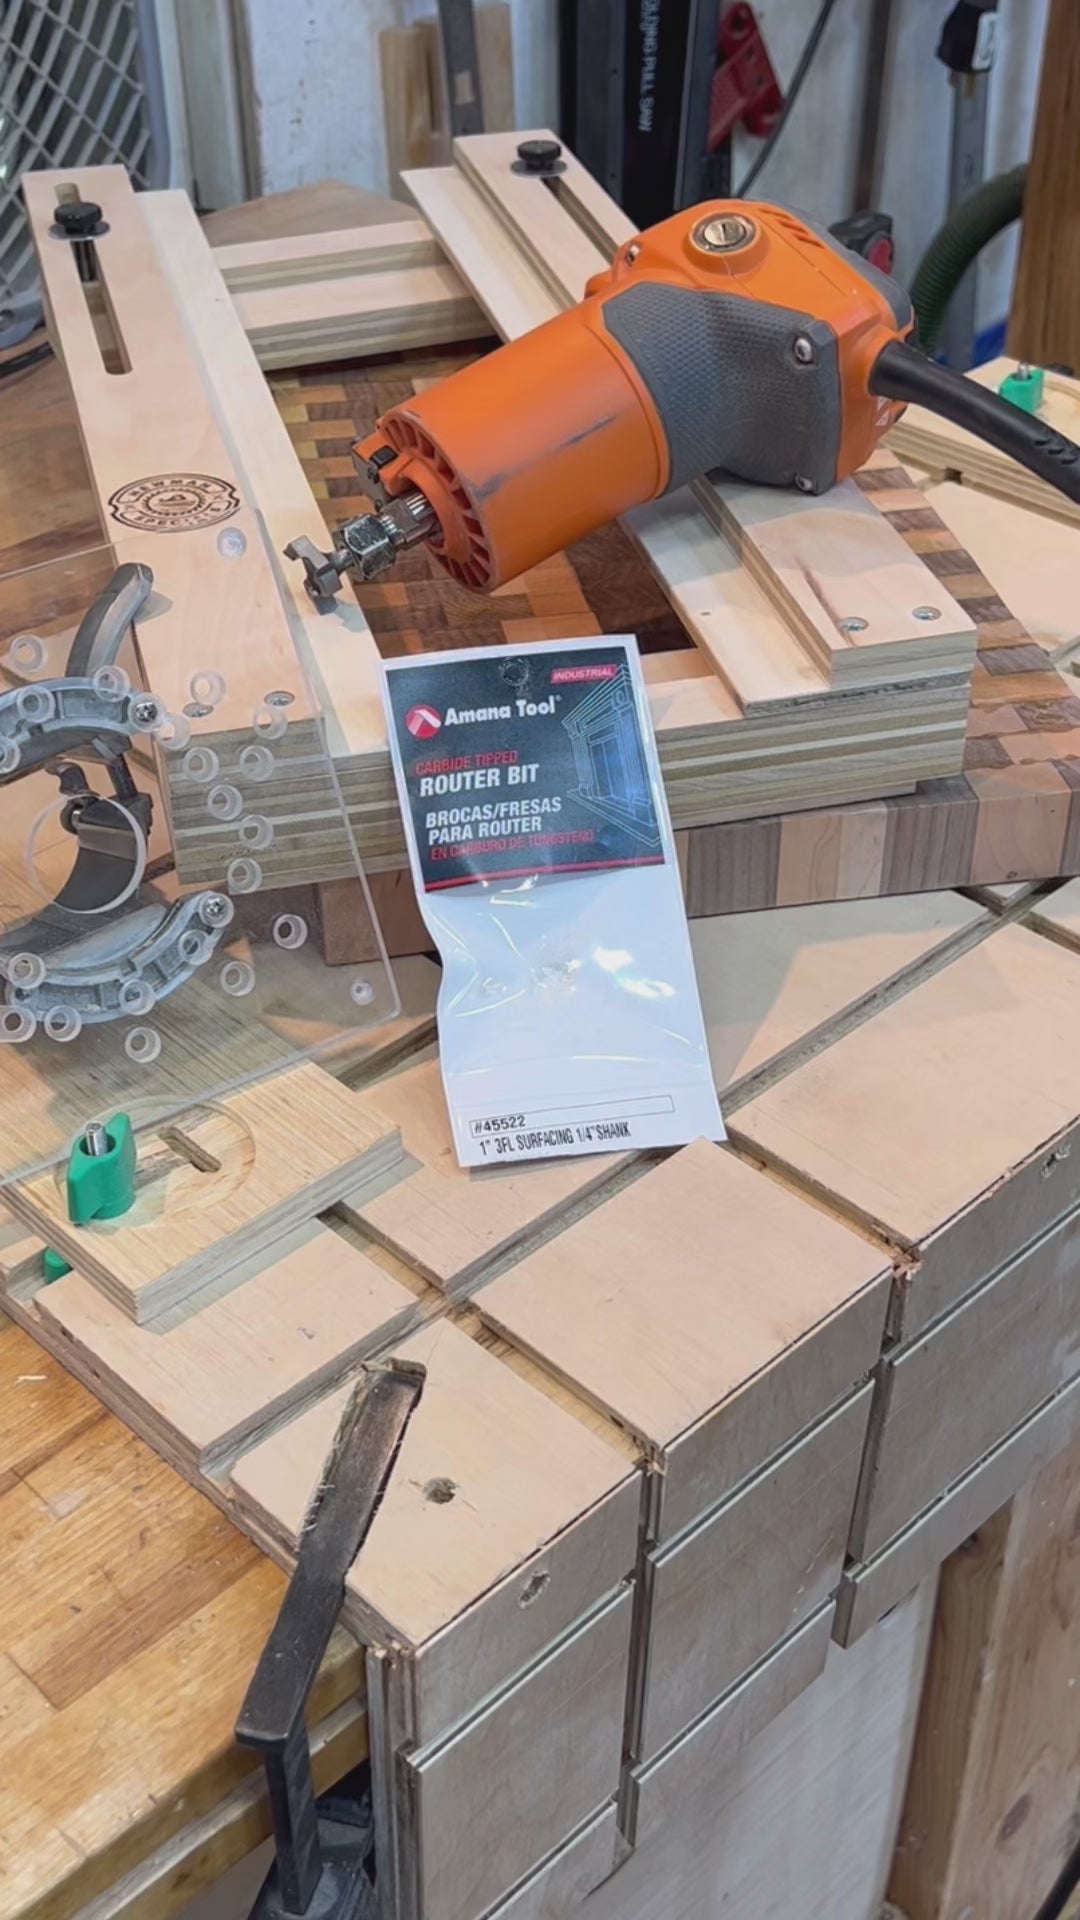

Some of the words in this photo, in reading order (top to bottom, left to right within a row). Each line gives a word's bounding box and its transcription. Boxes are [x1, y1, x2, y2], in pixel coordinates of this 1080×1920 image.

[637, 96, 655, 132] SAW
[552, 666, 615, 681] INDUSTRIAL
[444, 706, 511, 727] Amana
[415, 754, 471, 776] CARBIDE
[474, 750, 519, 768] TIPPED
[419, 767, 501, 798] ROUTER
[506, 763, 540, 786] BIT
[425, 796, 562, 829] BROCAS/FRESAS
[428, 825, 473, 846] PARA
[478, 816, 543, 838] ROUTER
[431, 846, 447, 861] EN
[450, 838, 509, 858] CARBURO
[511, 836, 526, 850] DE
[527, 829, 594, 848] TUNGSTENO
[474, 1115, 526, 1133] #45522
[480, 1138, 491, 1156] 1"
[495, 1136, 513, 1155] 3FL
[517, 1130, 574, 1151] SURFACING
